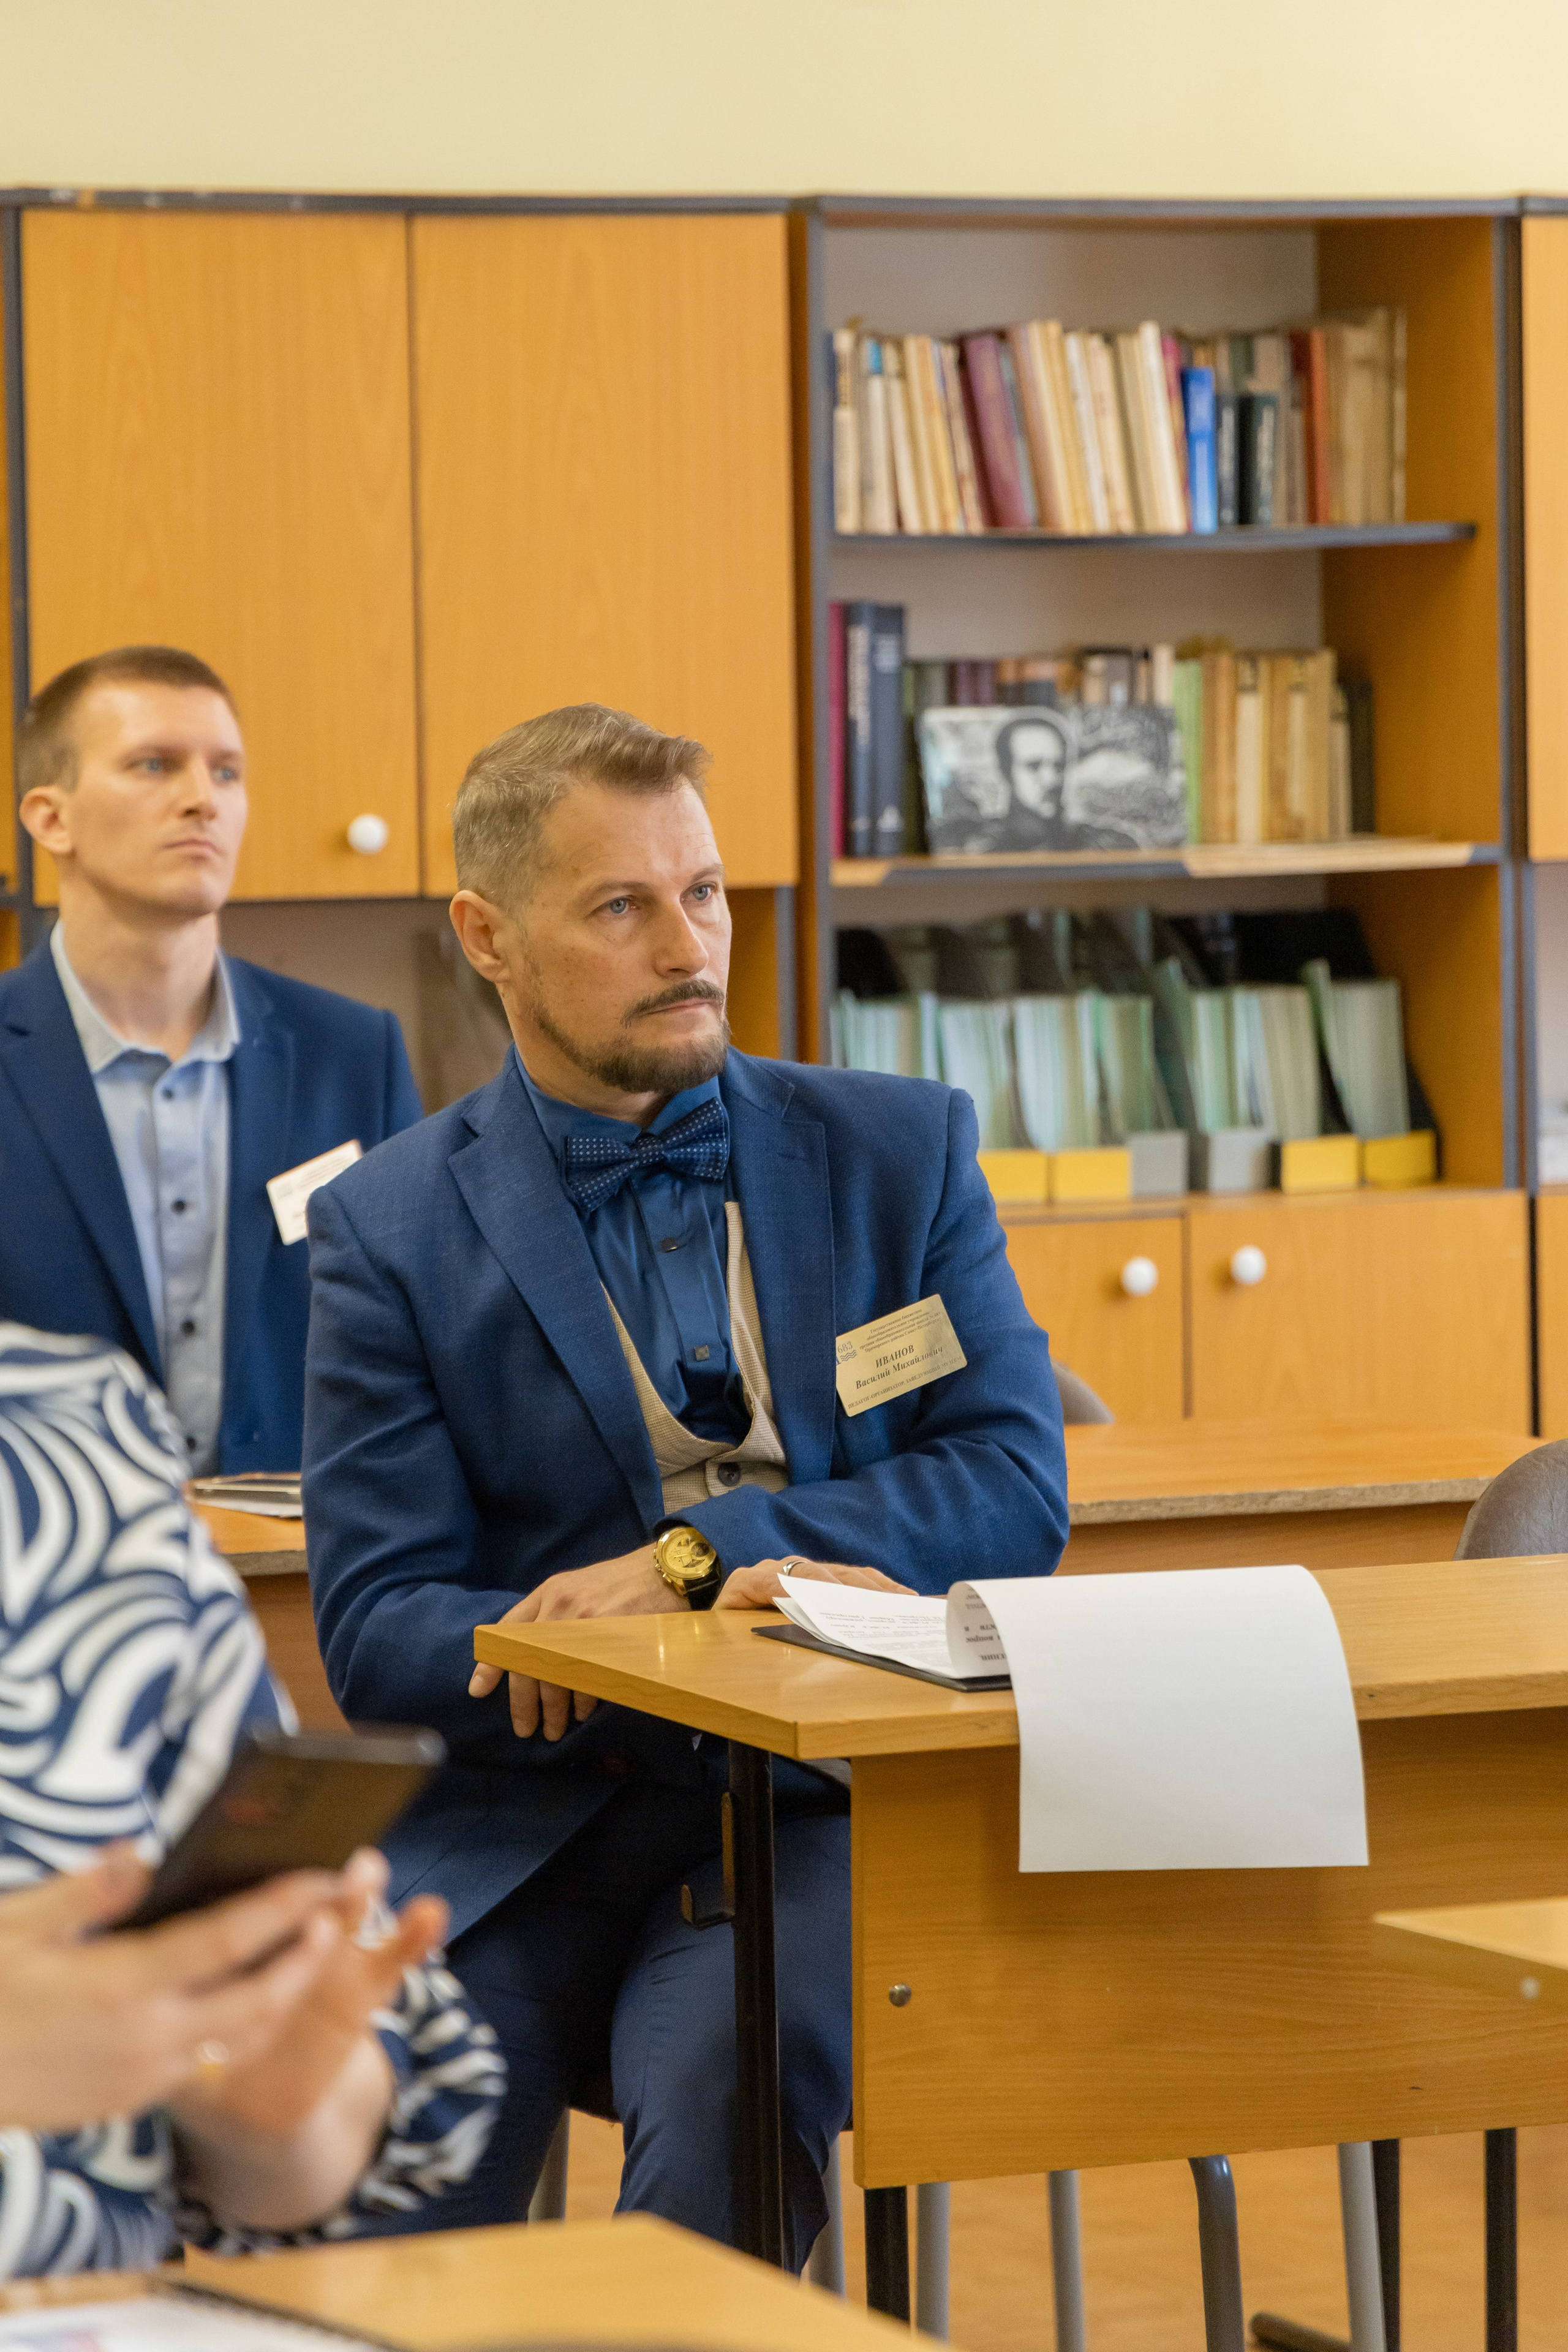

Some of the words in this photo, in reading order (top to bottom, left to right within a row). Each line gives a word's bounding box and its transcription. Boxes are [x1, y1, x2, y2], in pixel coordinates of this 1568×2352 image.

[837, 1341, 853, 1354] 683
[876, 1344, 914, 1368] ИВАНОВ
[856, 1368, 890, 1389] Василий
[892, 1346, 943, 1373] Михайлович
[848, 1381, 905, 1408] ПЕДАГОГ-ОРГАНИЗАТОР,
